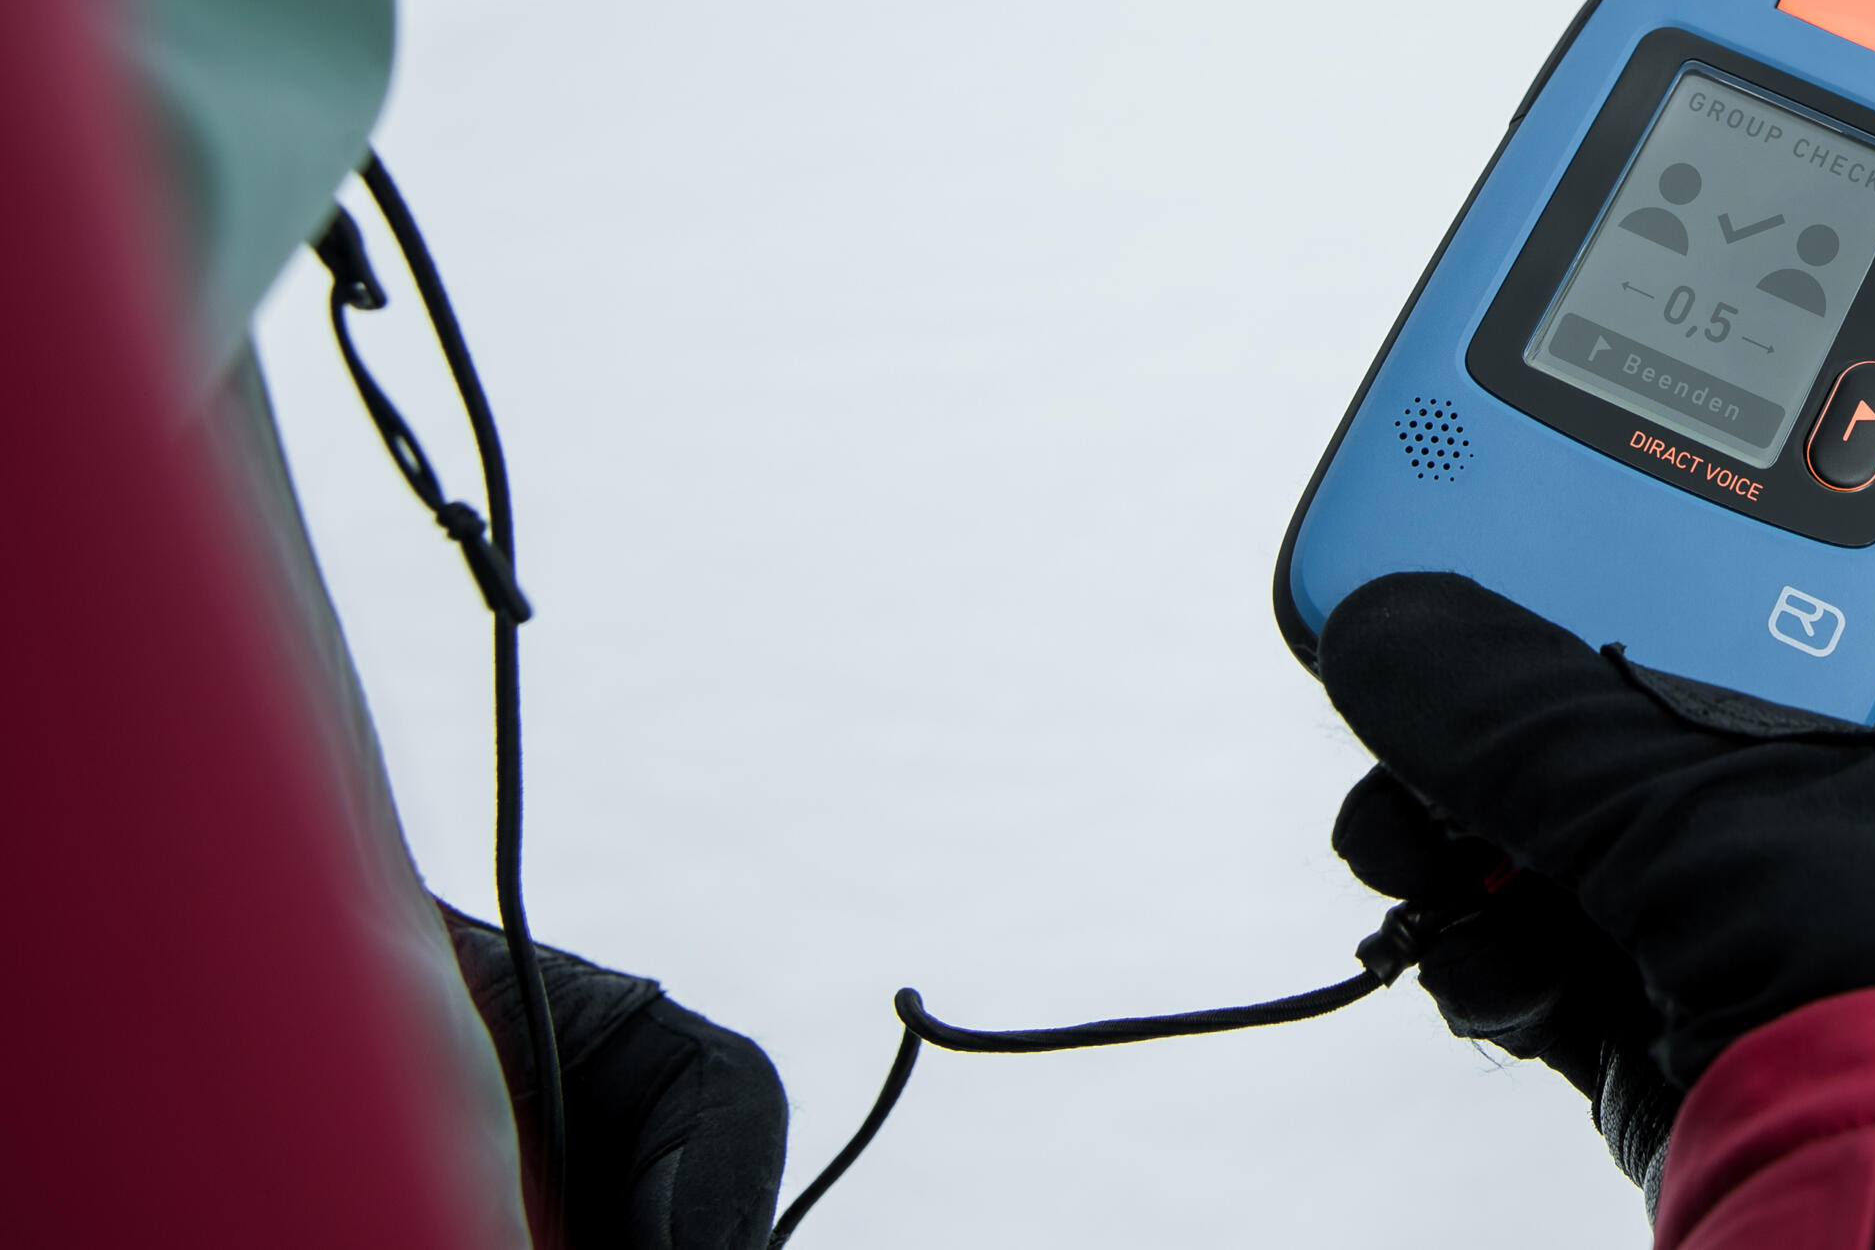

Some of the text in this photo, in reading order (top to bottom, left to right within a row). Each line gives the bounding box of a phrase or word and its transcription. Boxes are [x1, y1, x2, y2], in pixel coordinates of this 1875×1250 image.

[1688, 91, 1784, 143] GROUP
[1663, 285, 1740, 344] 0,5
[1622, 353, 1741, 421] Beenden
[1629, 430, 1764, 502] DIRACT VOICE
